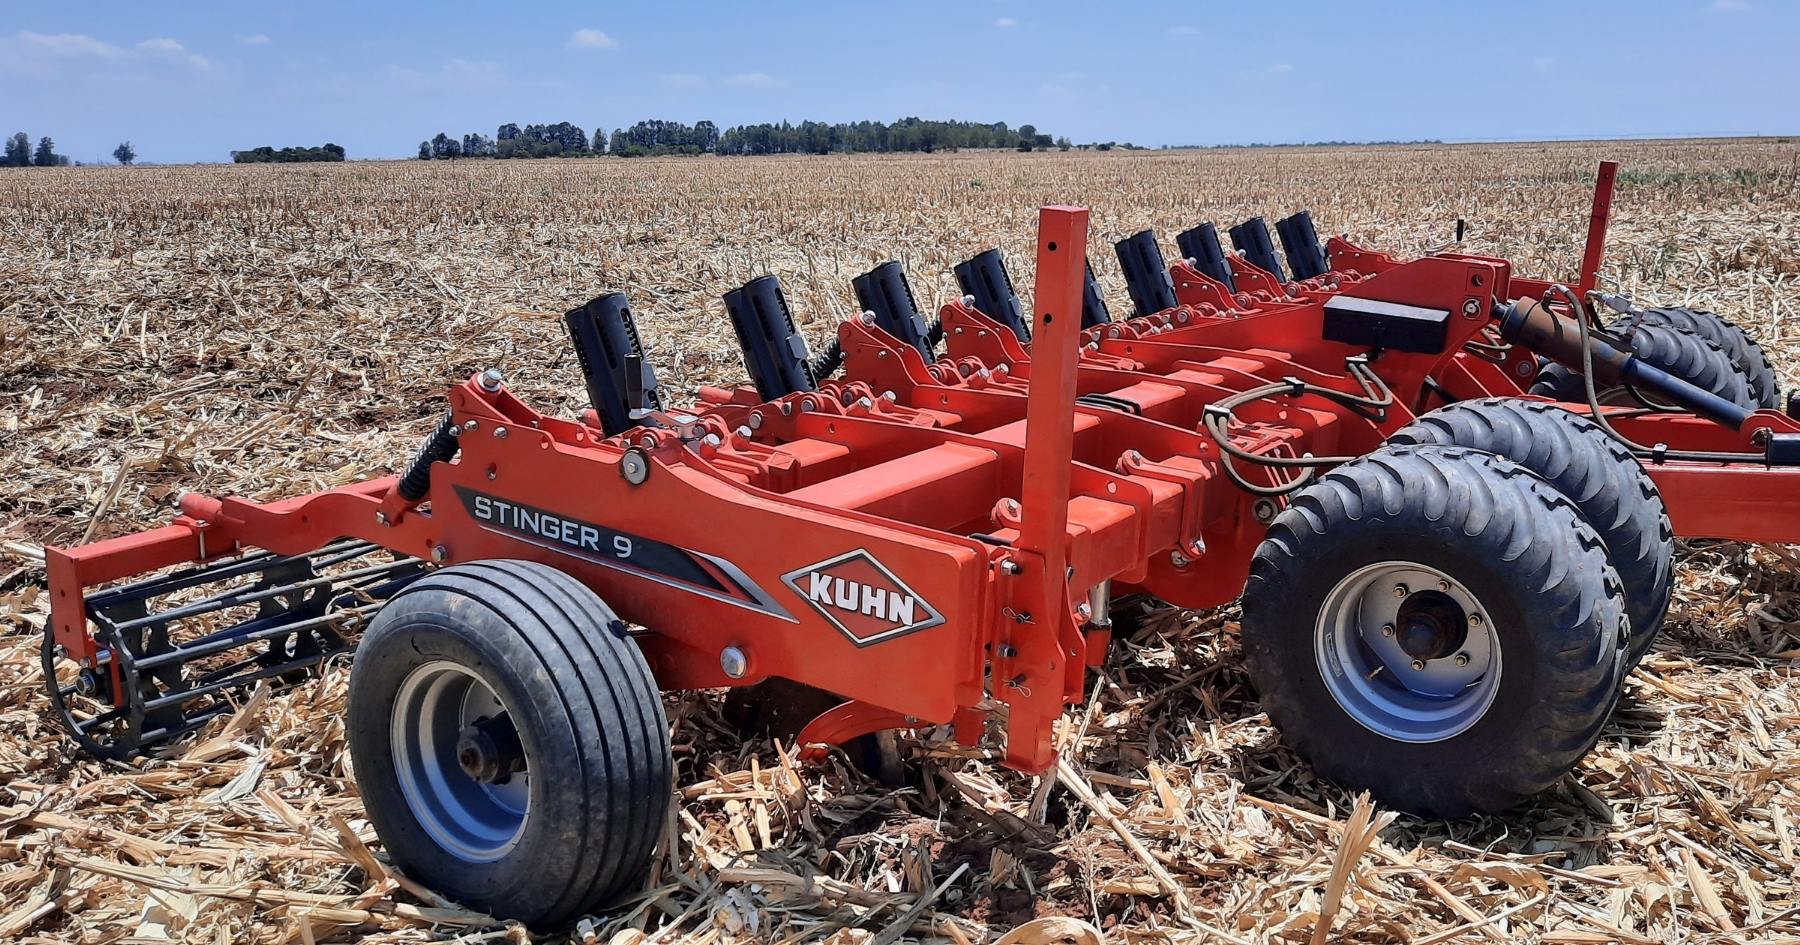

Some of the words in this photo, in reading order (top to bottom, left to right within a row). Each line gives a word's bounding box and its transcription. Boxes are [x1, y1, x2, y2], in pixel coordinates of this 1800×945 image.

[474, 496, 600, 552] STINGER
[613, 535, 633, 559] 9
[809, 571, 915, 627] KUHN
